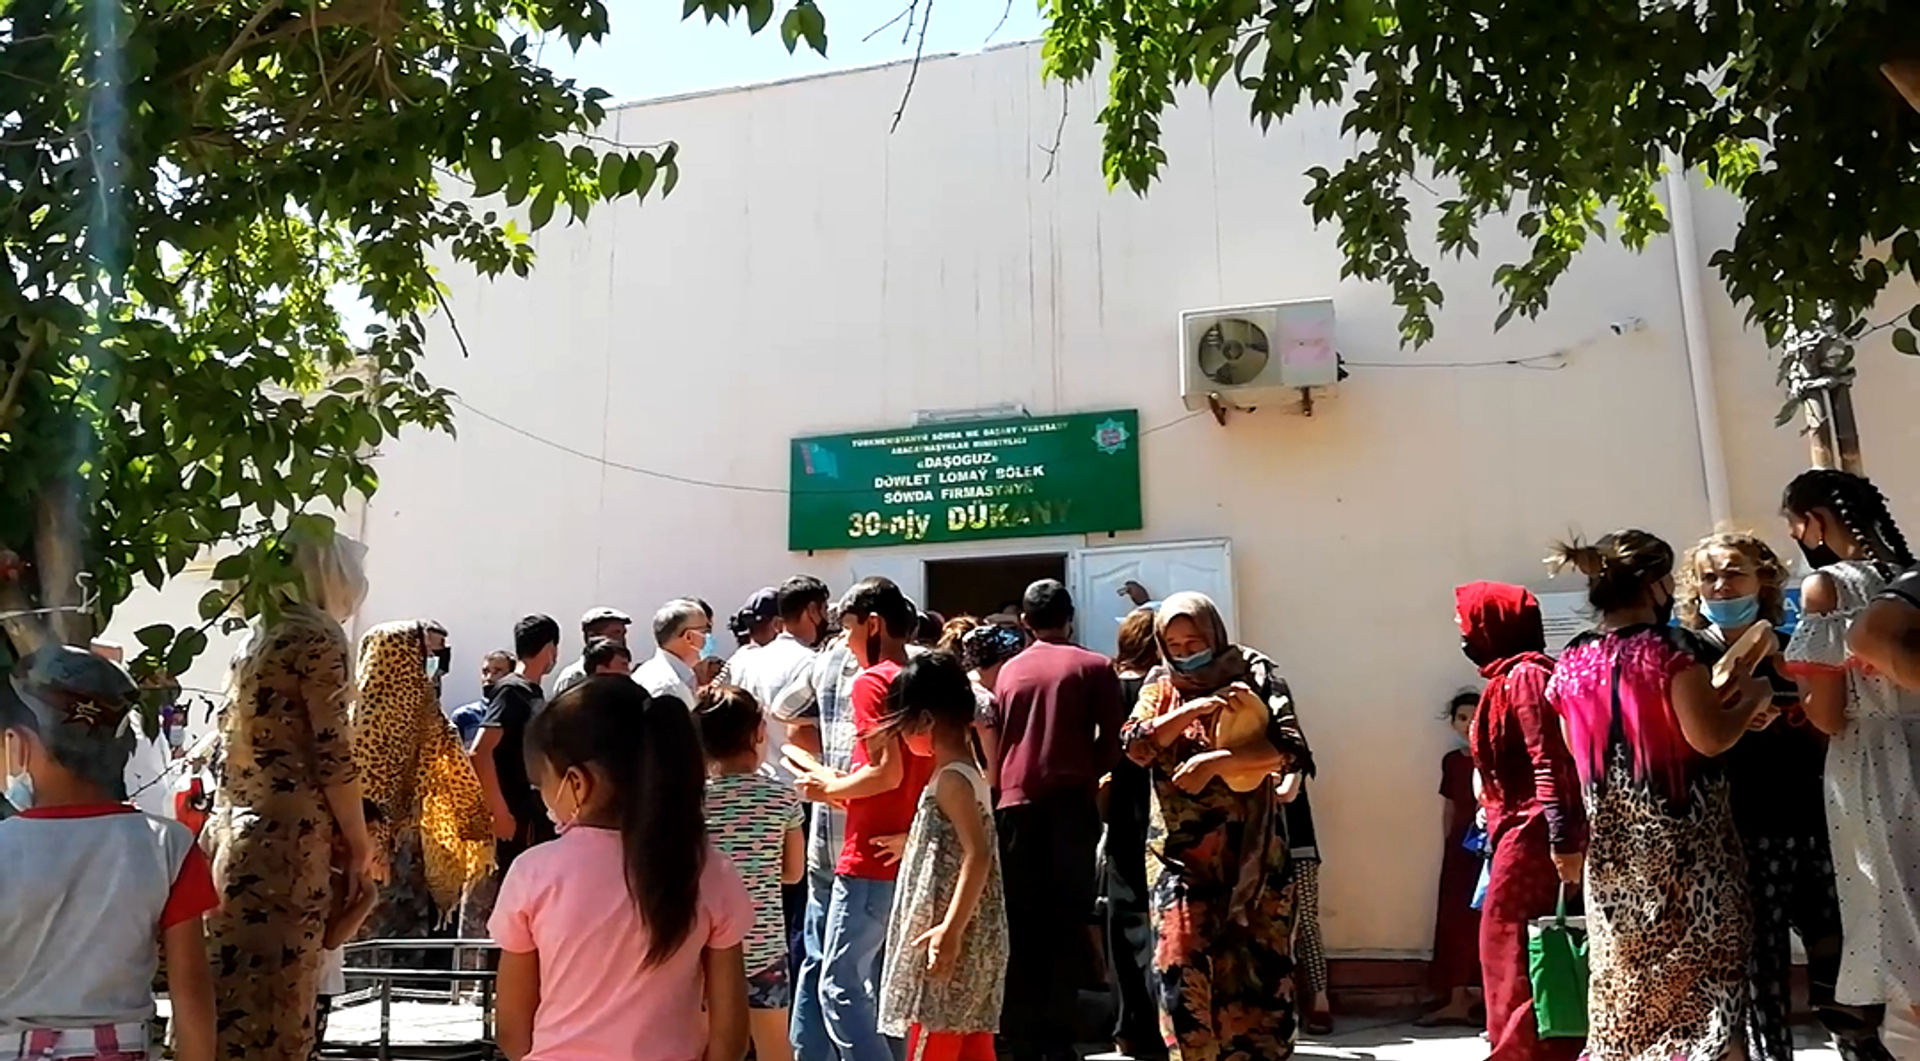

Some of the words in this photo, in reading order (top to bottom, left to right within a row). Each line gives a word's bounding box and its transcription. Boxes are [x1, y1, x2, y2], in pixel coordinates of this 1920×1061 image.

[875, 473, 932, 488] DÖWLET
[939, 466, 988, 484] LOMAÝ
[995, 464, 1045, 480] BÖLEK
[884, 488, 933, 504] SÖWDA
[848, 508, 931, 539] 30-njy
